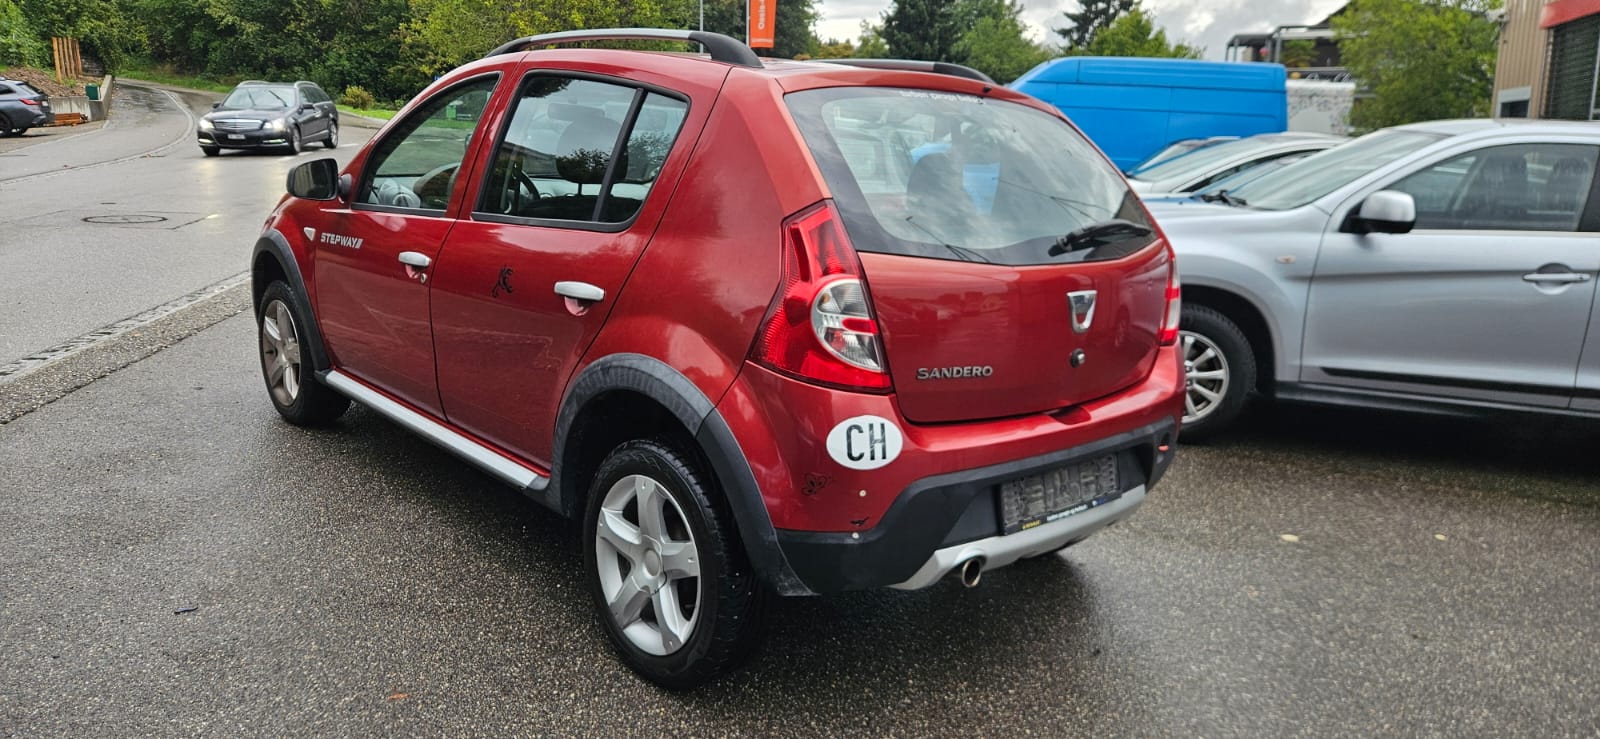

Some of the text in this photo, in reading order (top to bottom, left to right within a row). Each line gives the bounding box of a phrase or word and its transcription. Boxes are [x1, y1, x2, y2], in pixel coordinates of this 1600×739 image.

[320, 232, 357, 249] STEPWAY
[917, 365, 993, 380] SANDERO
[846, 423, 887, 462] CH
